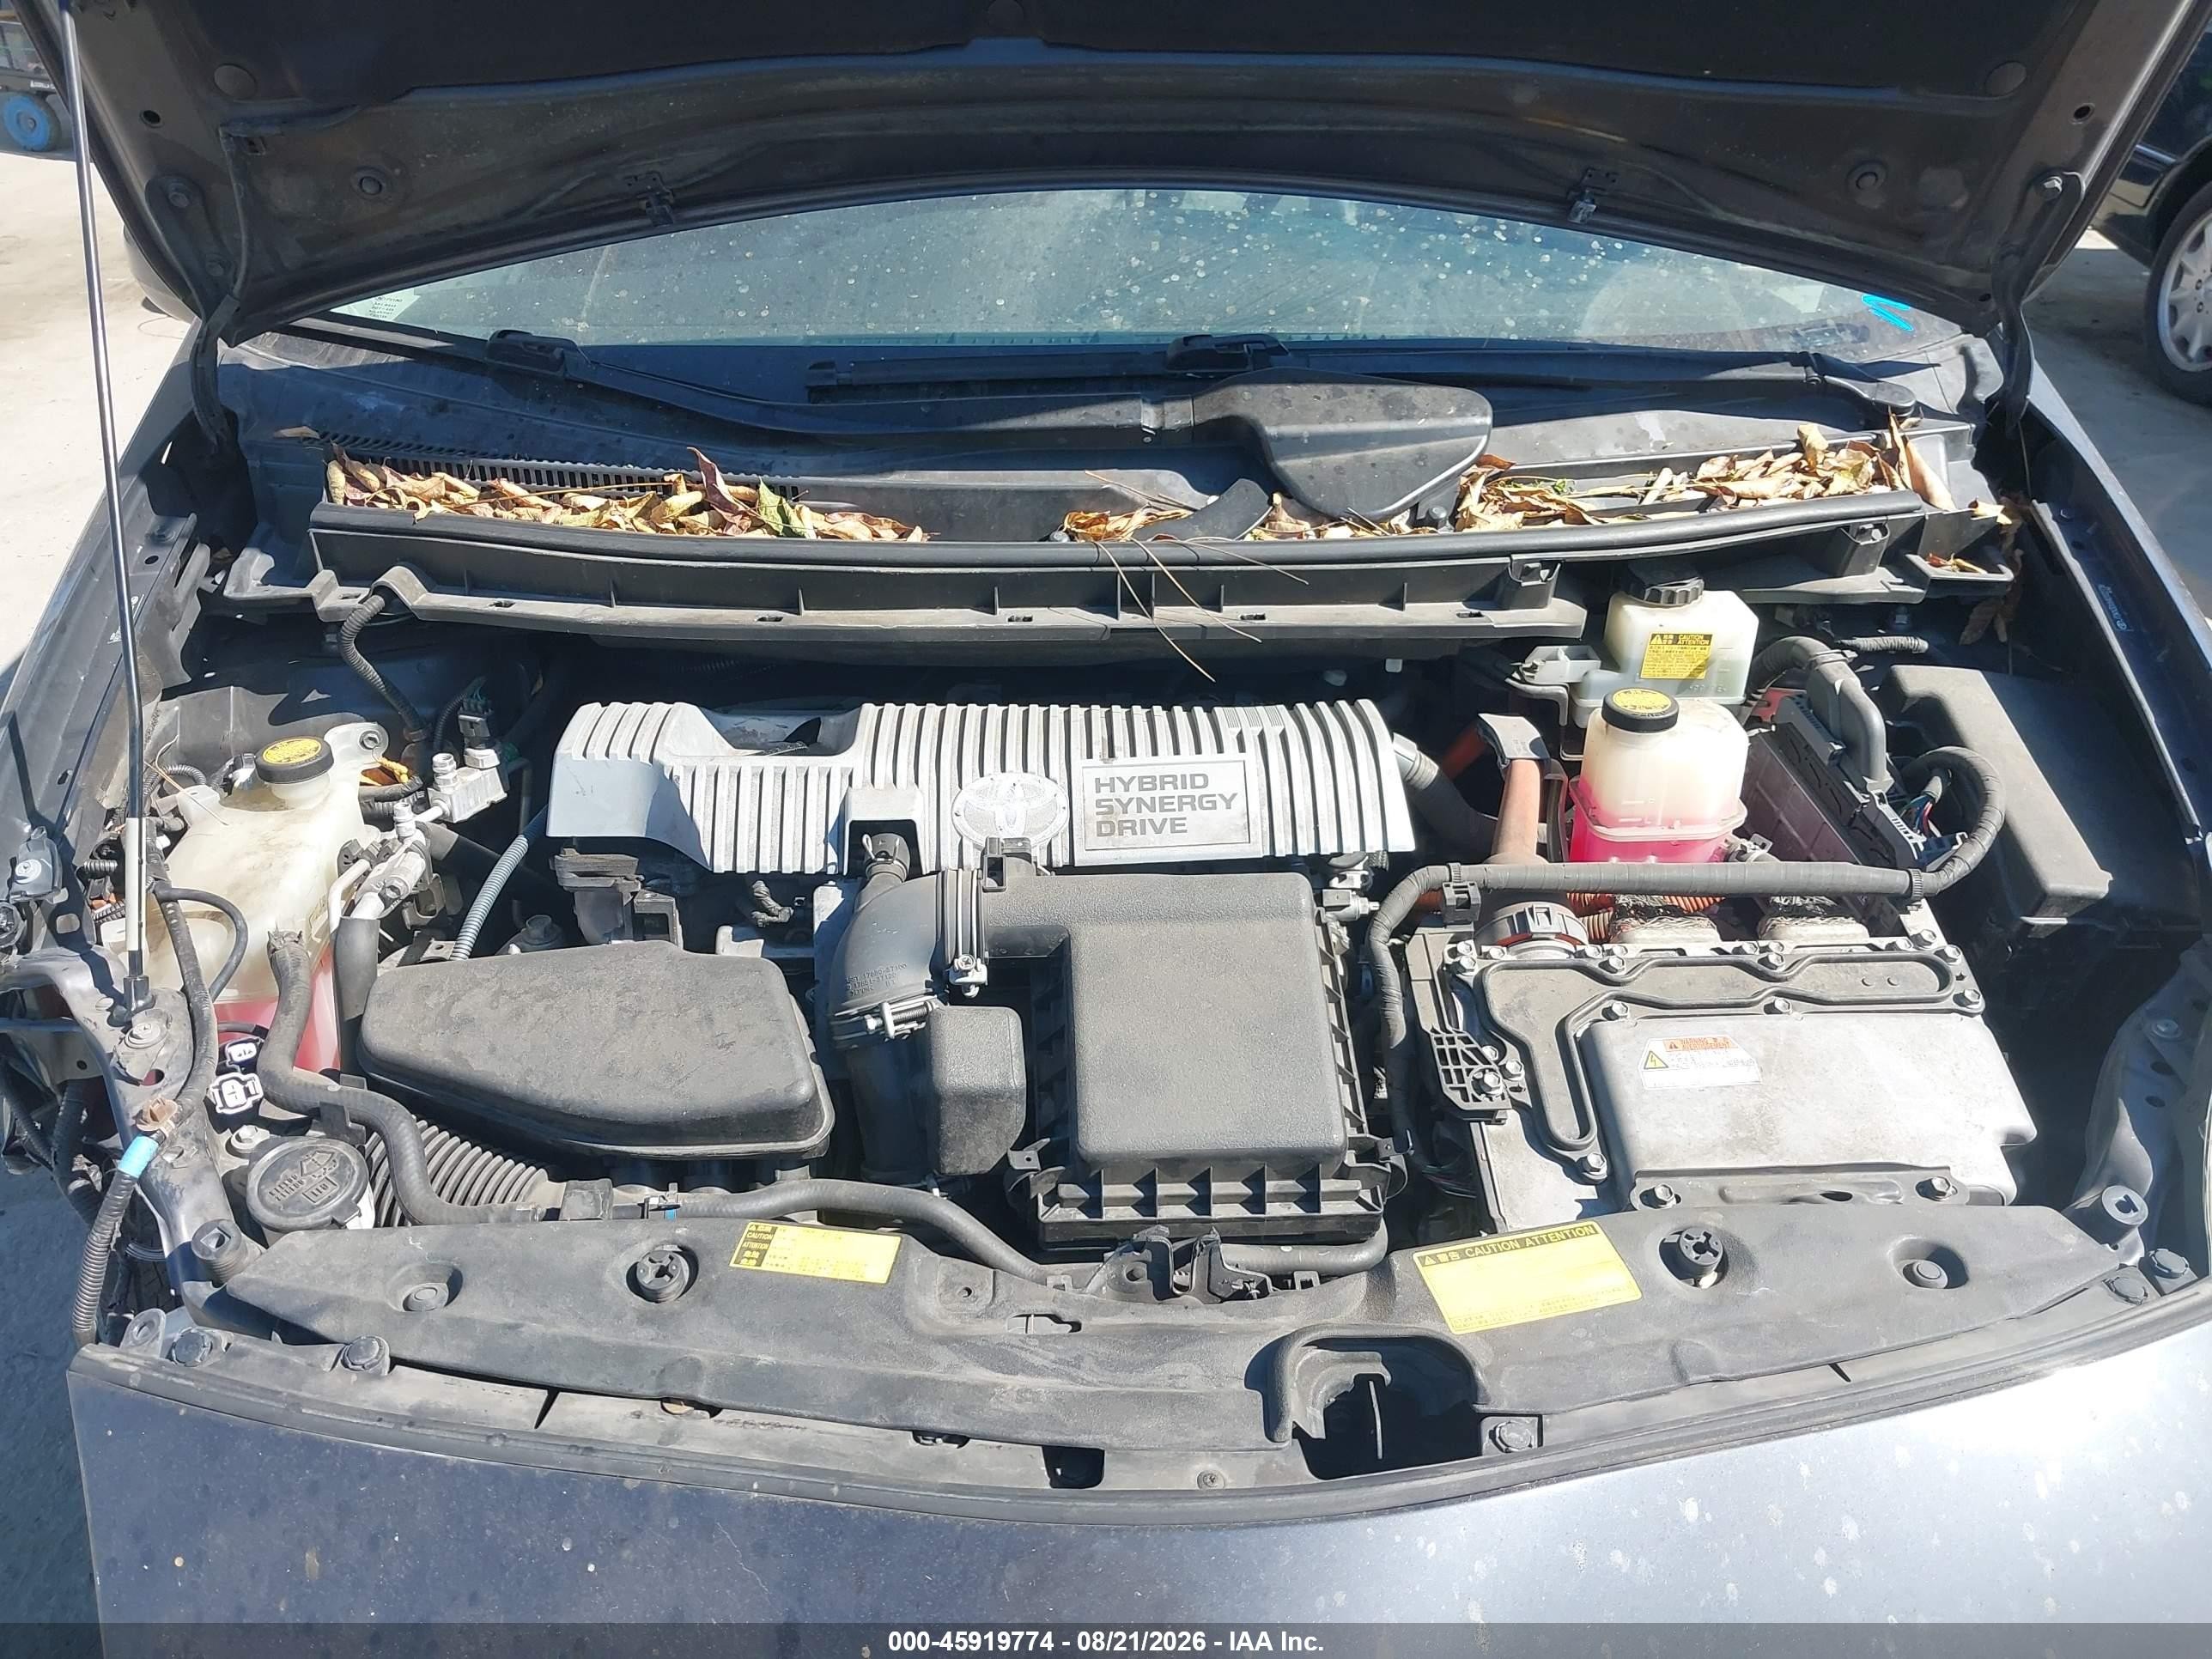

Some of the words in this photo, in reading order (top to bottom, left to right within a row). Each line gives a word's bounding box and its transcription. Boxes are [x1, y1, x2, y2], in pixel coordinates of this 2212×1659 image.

[1095, 773, 1209, 793] HYBRID
[1095, 793, 1238, 816] SYNERGY
[1096, 817, 1188, 837] DRIVE
[746, 1231, 773, 1240] CAUTION
[1465, 1240, 1522, 1259] CAUTION
[1525, 1225, 1596, 1248] ATTENTION
[742, 1242, 769, 1250] ATTENTION
